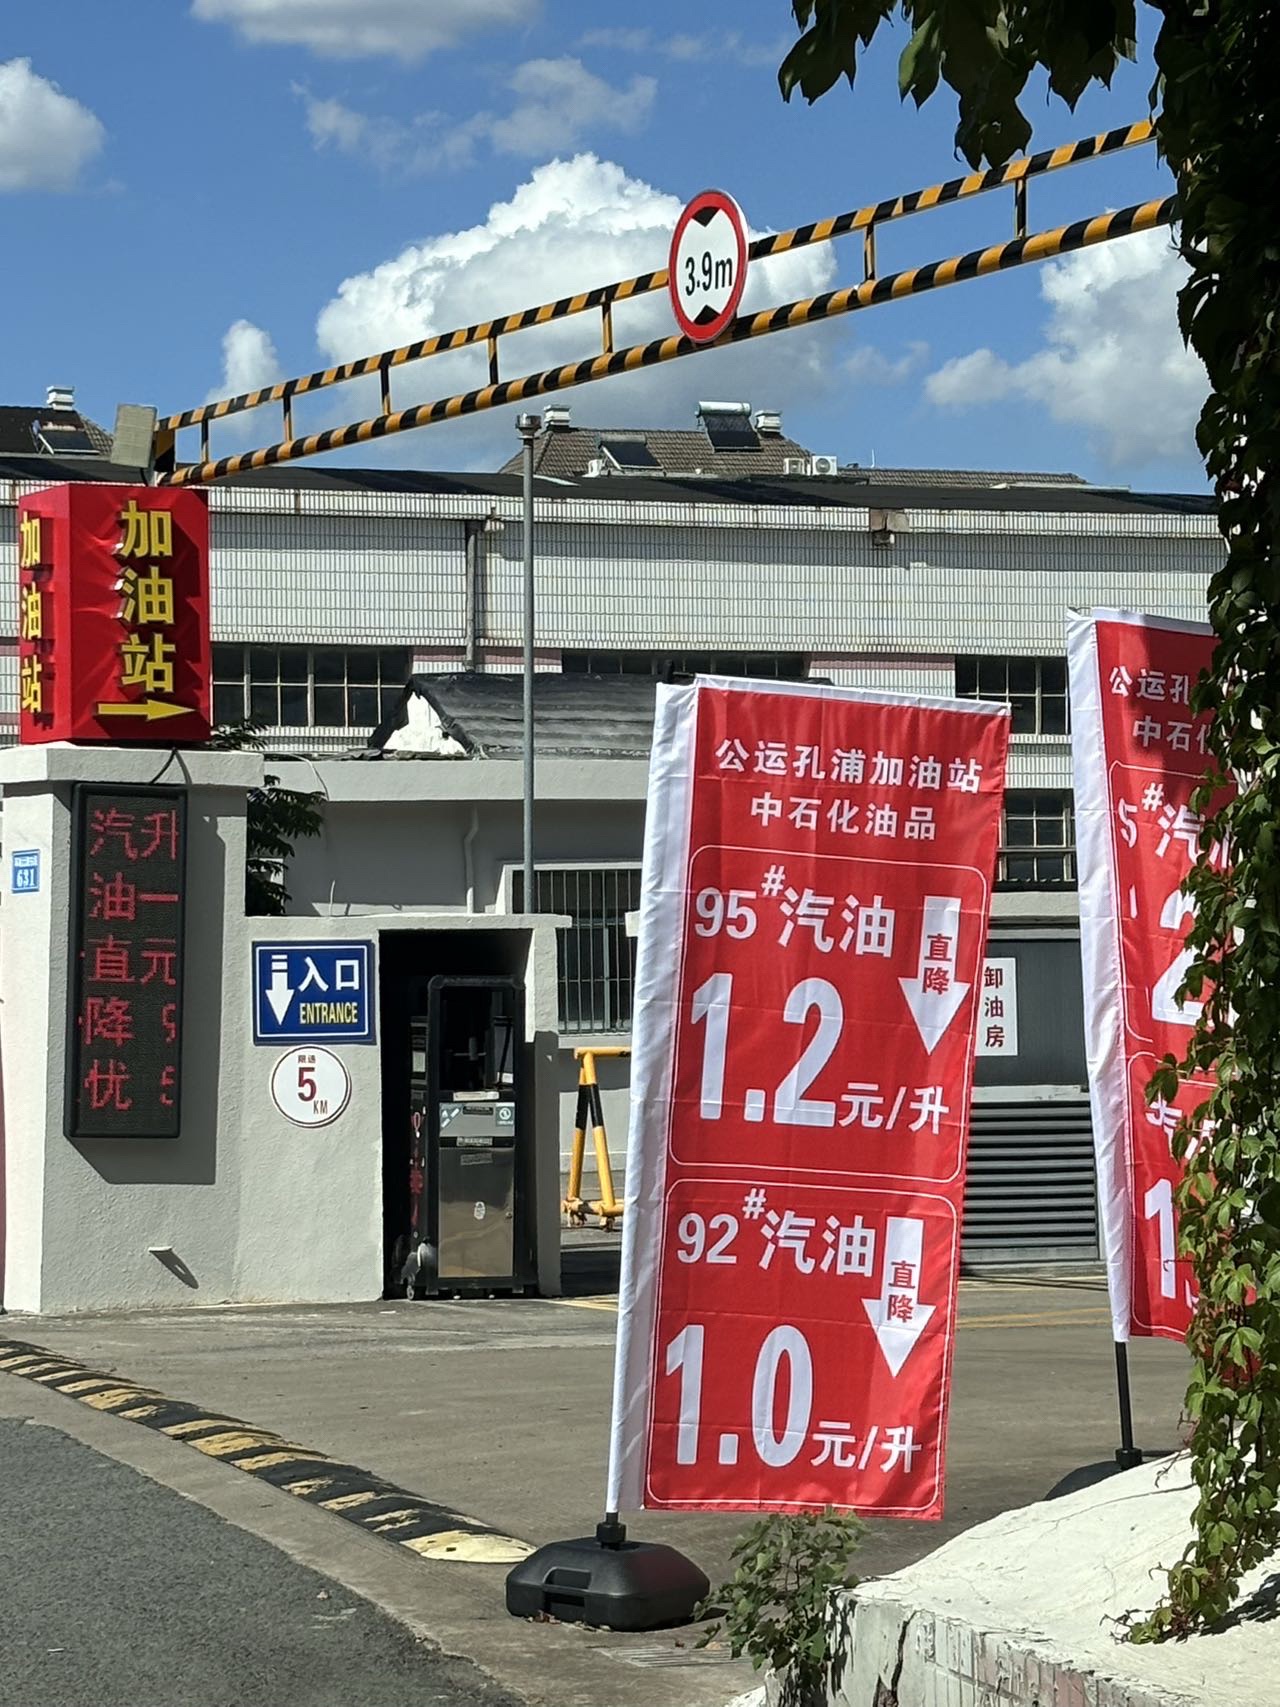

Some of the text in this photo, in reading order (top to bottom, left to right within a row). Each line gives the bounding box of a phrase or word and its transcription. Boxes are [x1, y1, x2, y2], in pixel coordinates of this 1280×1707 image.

[685, 251, 732, 296] 3.9m
[20, 511, 42, 714] 加油站
[119, 499, 176, 693] 加油站
[715, 738, 983, 794] 公运孔浦加油站
[751, 791, 935, 840] 中石化油品
[16, 869, 35, 887] 631
[298, 956, 360, 992] 入口
[922, 933, 953, 995] 直降
[300, 1002, 358, 1024] ENTRANCE
[984, 966, 1004, 1047] 卸油房
[298, 1067, 317, 1101] 5
[313, 1100, 328, 1114] KM
[887, 1260, 916, 1323] 直降
